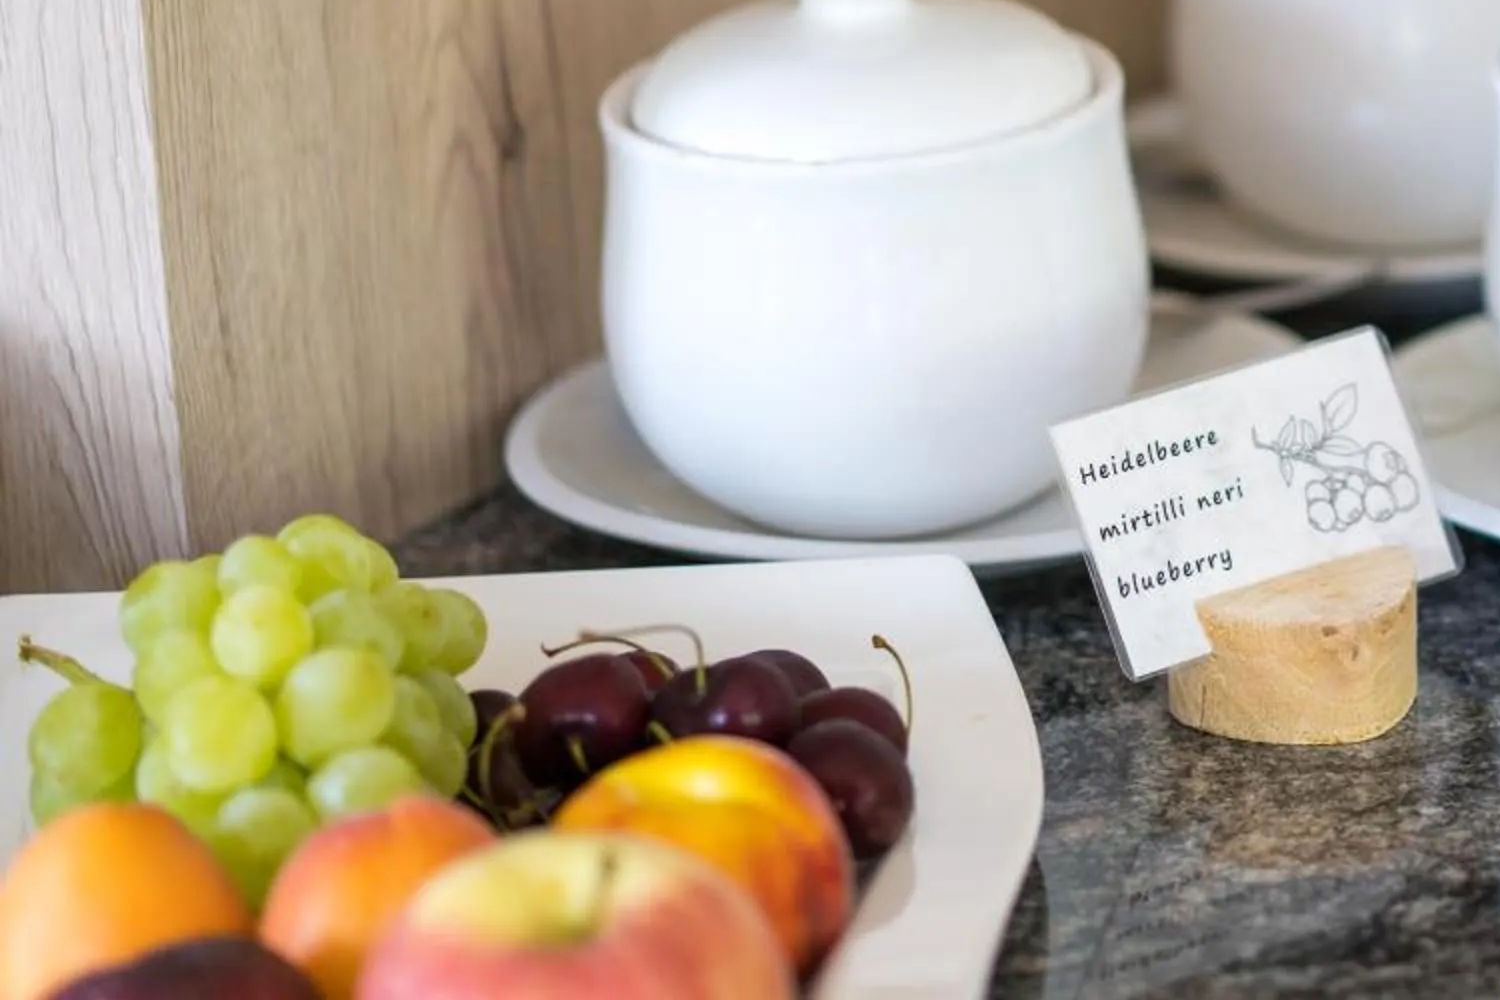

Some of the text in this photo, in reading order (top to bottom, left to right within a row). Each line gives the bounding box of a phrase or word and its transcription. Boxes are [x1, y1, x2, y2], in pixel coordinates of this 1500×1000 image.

[1079, 430, 1219, 485] Heidelbeere
[1099, 477, 1244, 542] mirtilli neri
[1116, 548, 1233, 598] blueberry
